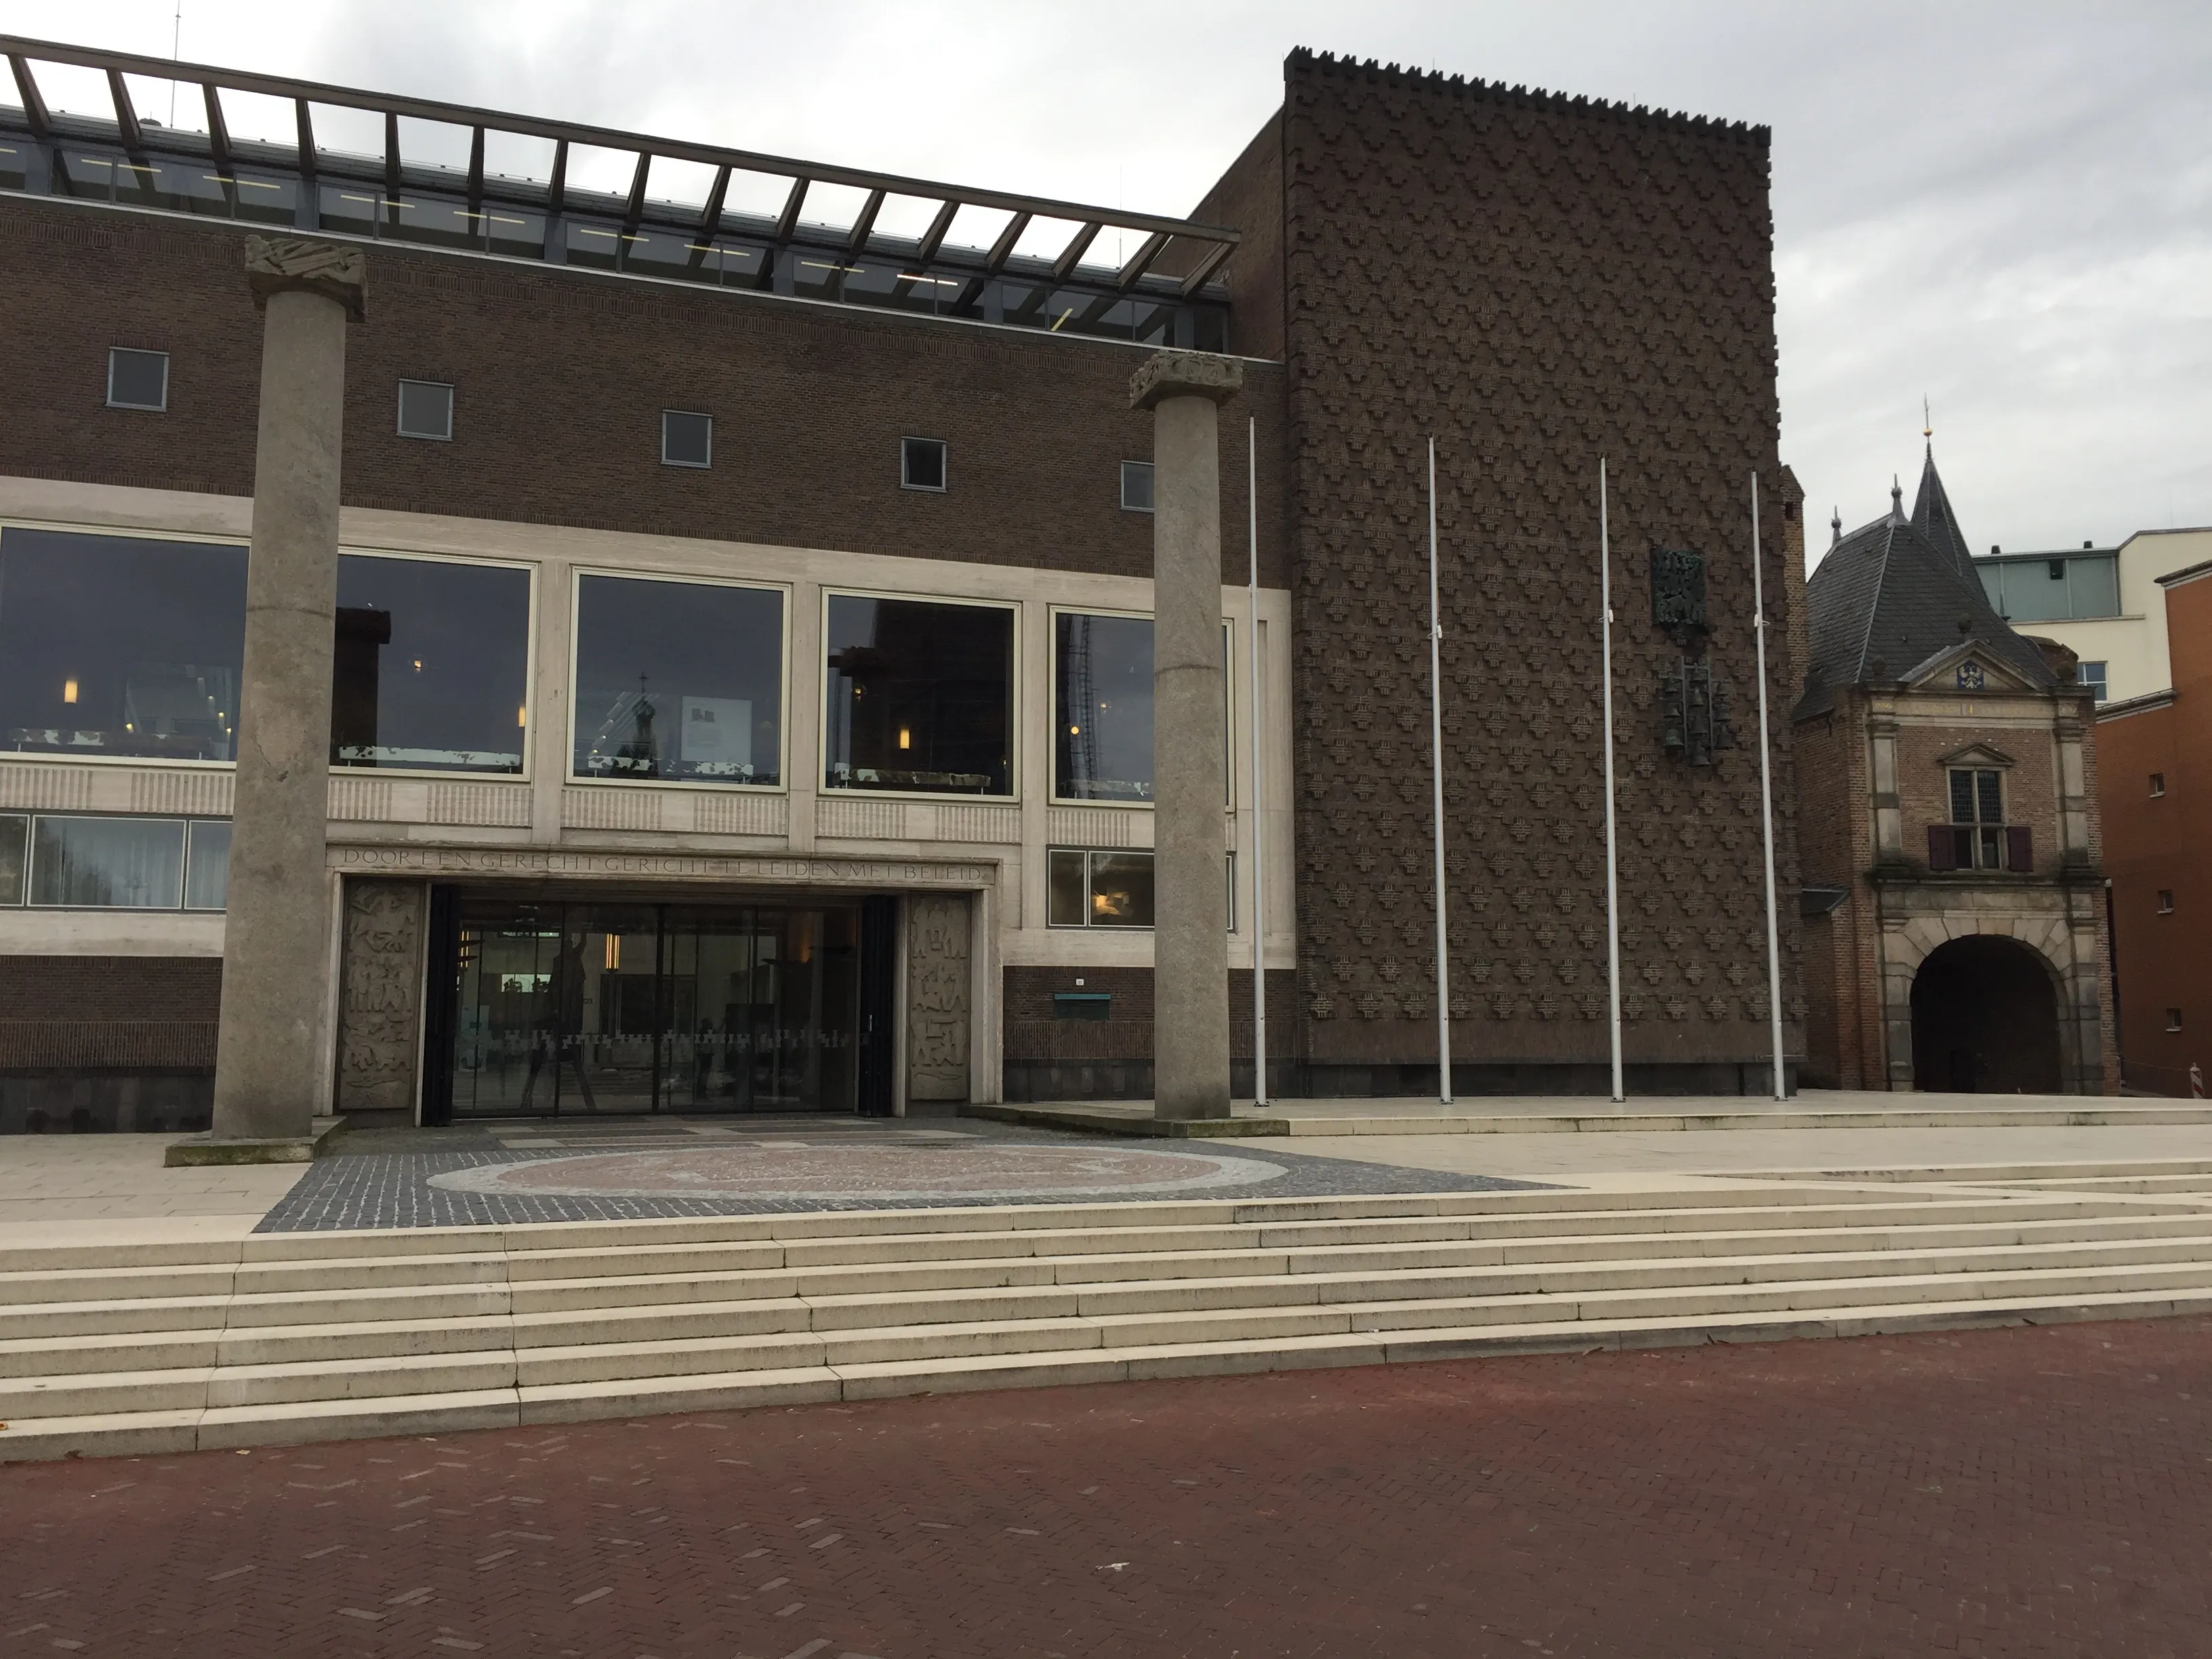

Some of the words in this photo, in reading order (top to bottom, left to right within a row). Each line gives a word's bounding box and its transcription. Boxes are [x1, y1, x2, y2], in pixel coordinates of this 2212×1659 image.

[344, 848, 412, 865] DOOR
[422, 851, 471, 866] EEN
[480, 853, 598, 870] GERECHT
[605, 857, 710, 874] GERICHT
[722, 860, 748, 874] TE
[757, 861, 840, 876] LEIDEN
[847, 863, 893, 878] MET
[903, 865, 981, 880] BELEID
